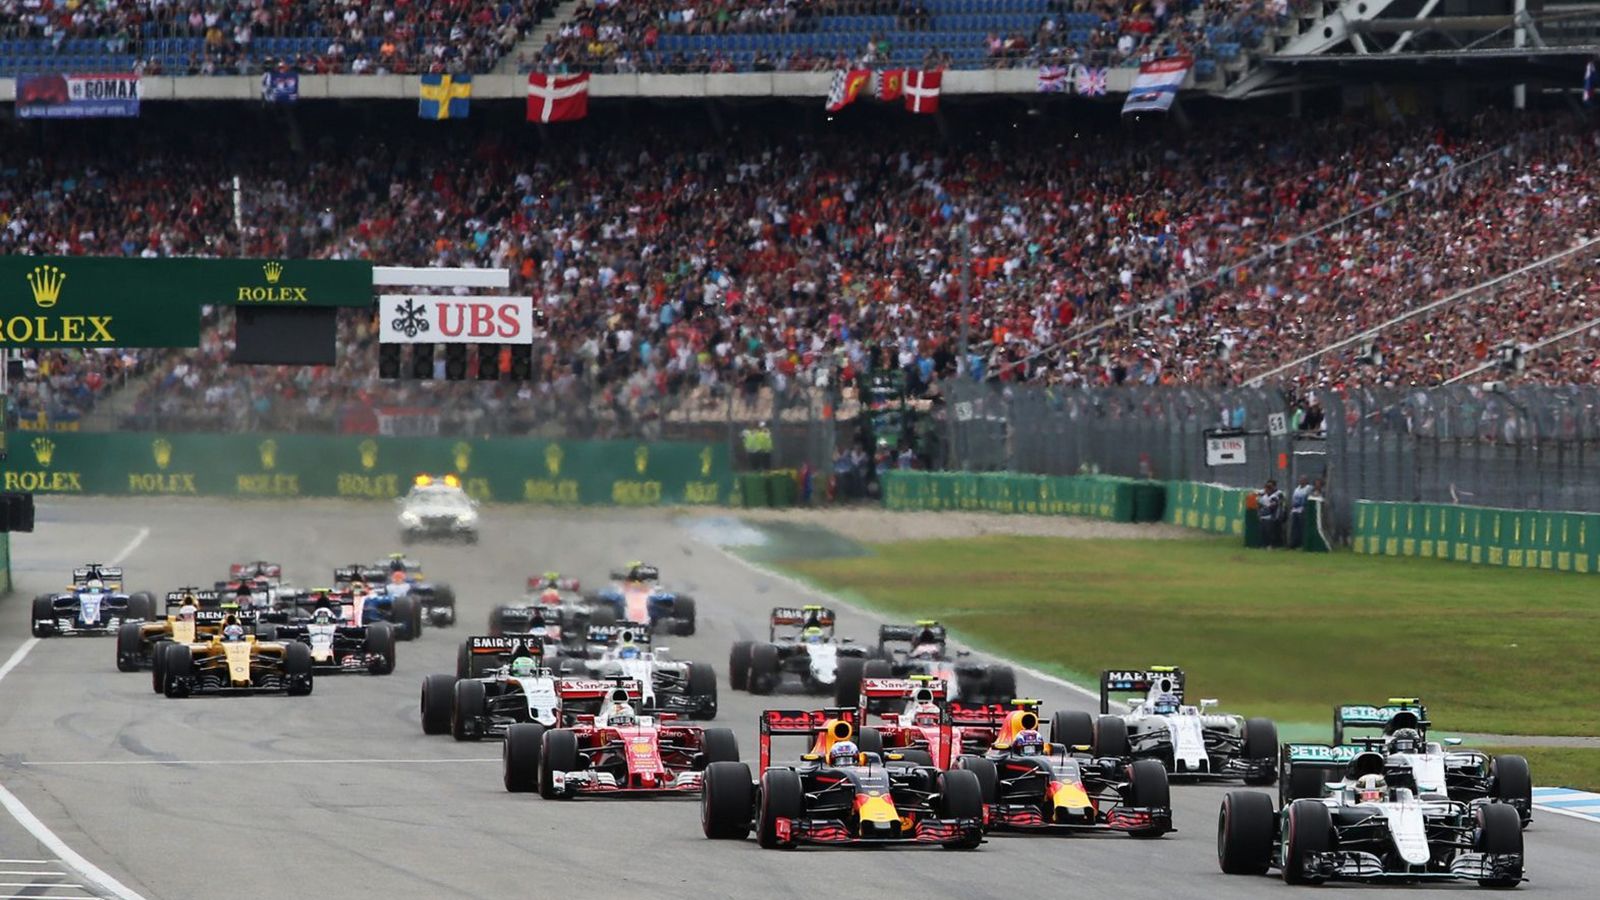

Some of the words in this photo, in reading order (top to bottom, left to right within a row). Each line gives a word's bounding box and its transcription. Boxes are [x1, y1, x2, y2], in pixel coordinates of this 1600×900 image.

[238, 287, 308, 301] ROLEX
[0, 316, 115, 342] OLEX
[435, 303, 520, 338] UBS
[5, 471, 82, 491] ROLEX
[128, 473, 196, 492] ROLEX
